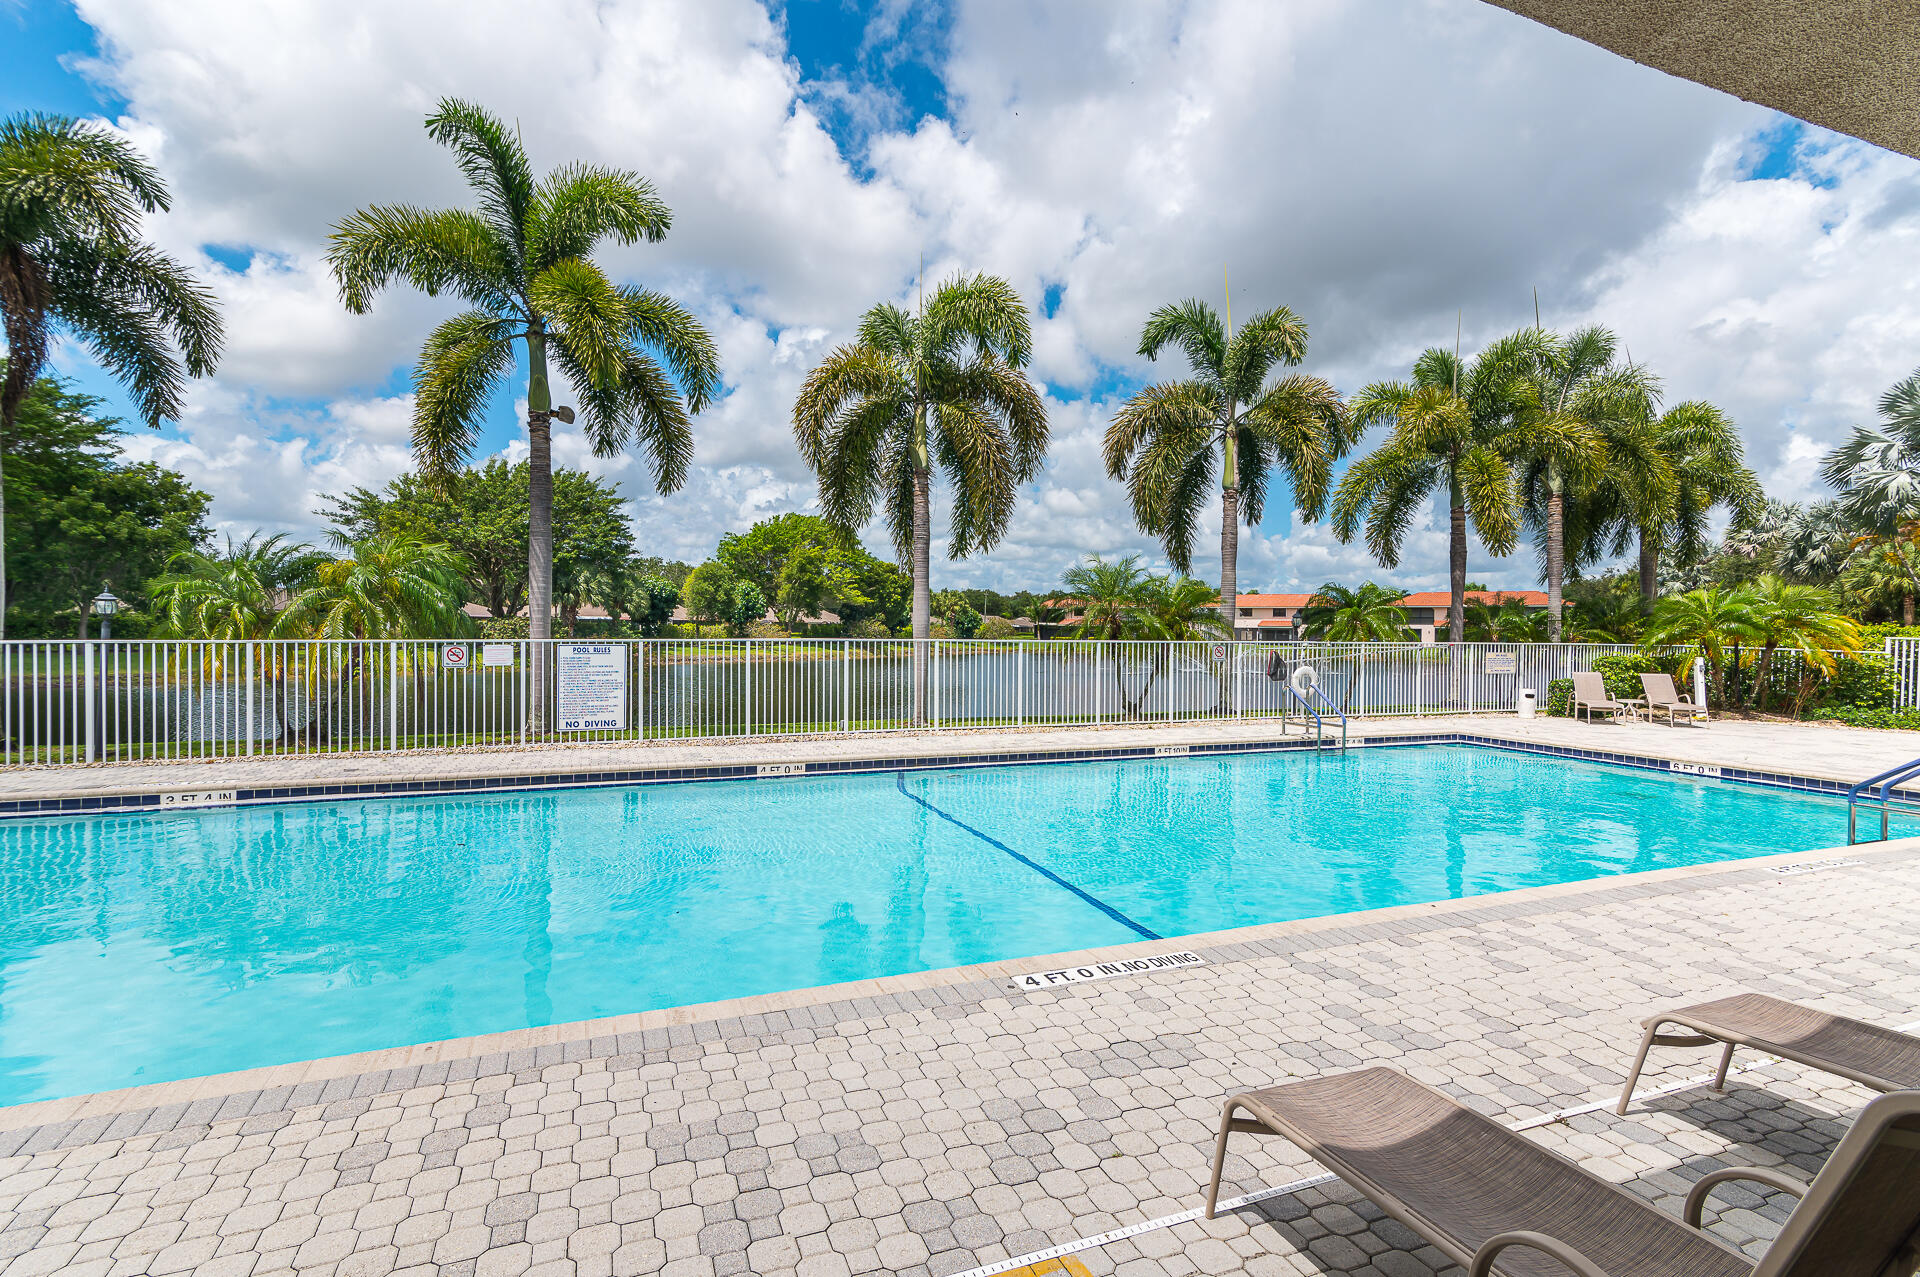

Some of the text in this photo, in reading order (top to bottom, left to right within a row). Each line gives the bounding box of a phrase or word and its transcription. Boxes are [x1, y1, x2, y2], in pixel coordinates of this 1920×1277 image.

[565, 719, 617, 728] NO DIVING
[1025, 975, 1041, 986] 4
[1043, 971, 1075, 984] FT.
[1121, 960, 1150, 972] NO
[1149, 952, 1199, 968] DIVING
